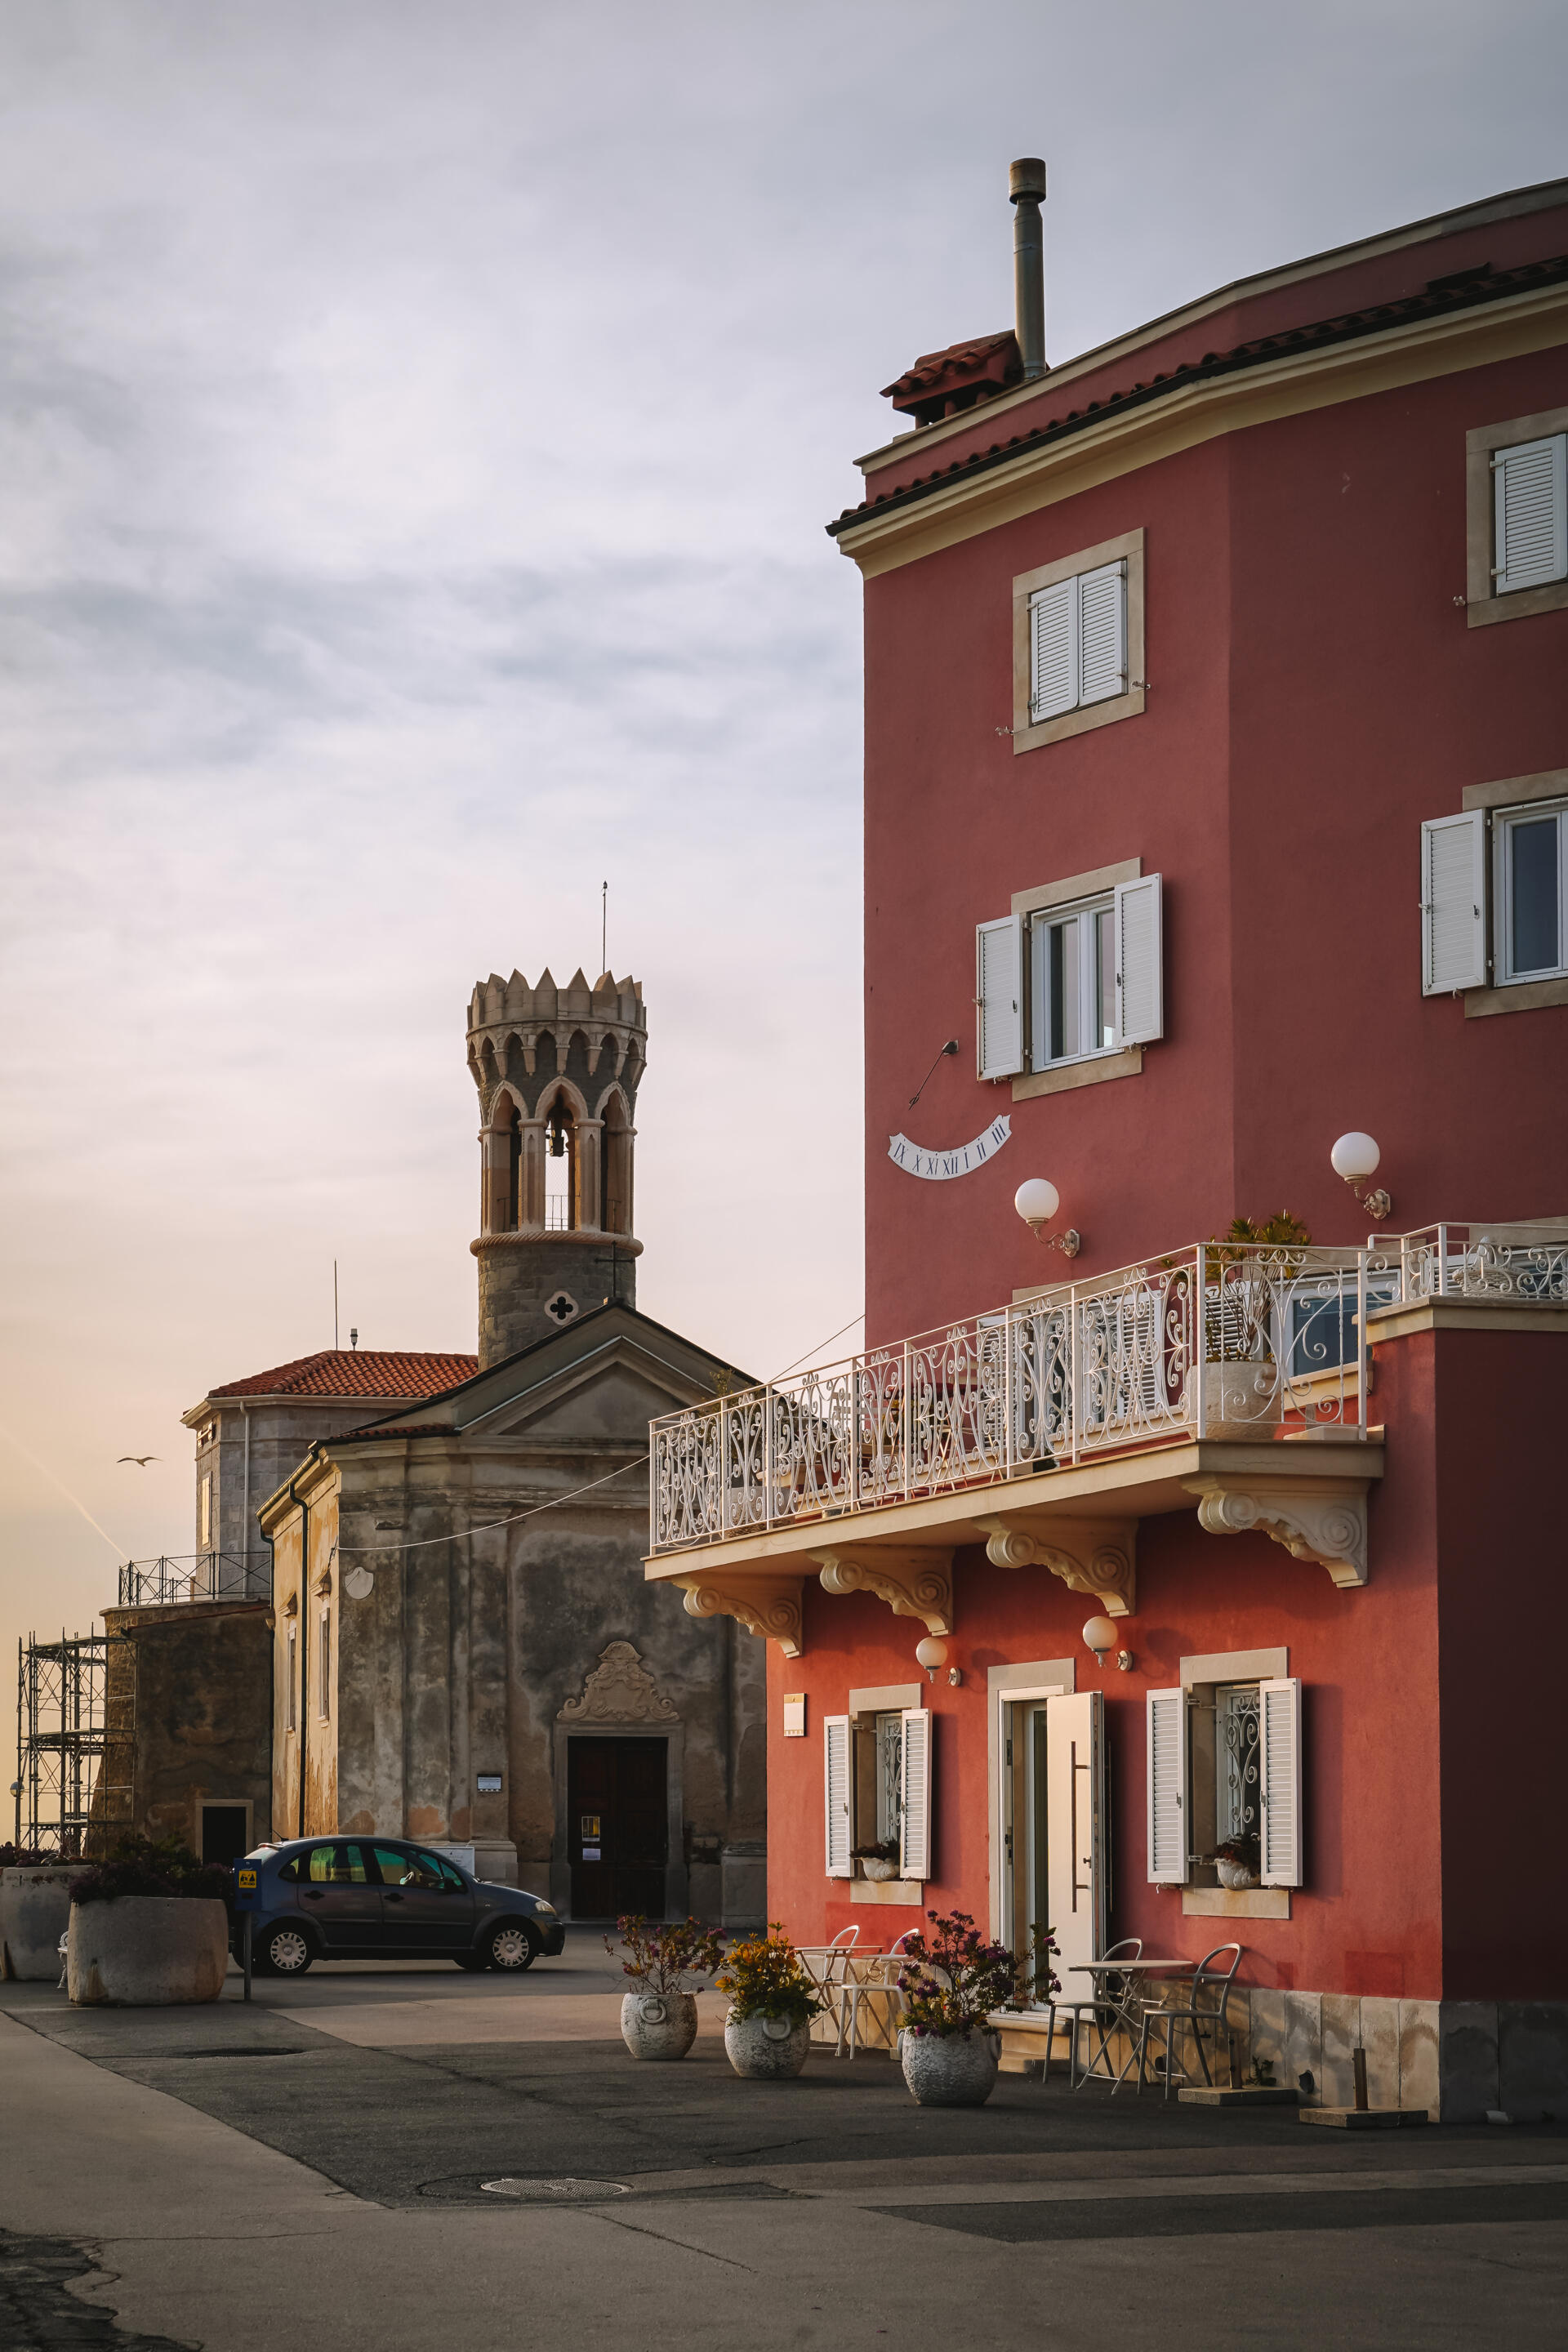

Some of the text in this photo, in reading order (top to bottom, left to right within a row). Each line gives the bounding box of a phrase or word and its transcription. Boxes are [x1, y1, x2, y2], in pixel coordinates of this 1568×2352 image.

[893, 1124, 1006, 1176] IX X XI XII I II III
